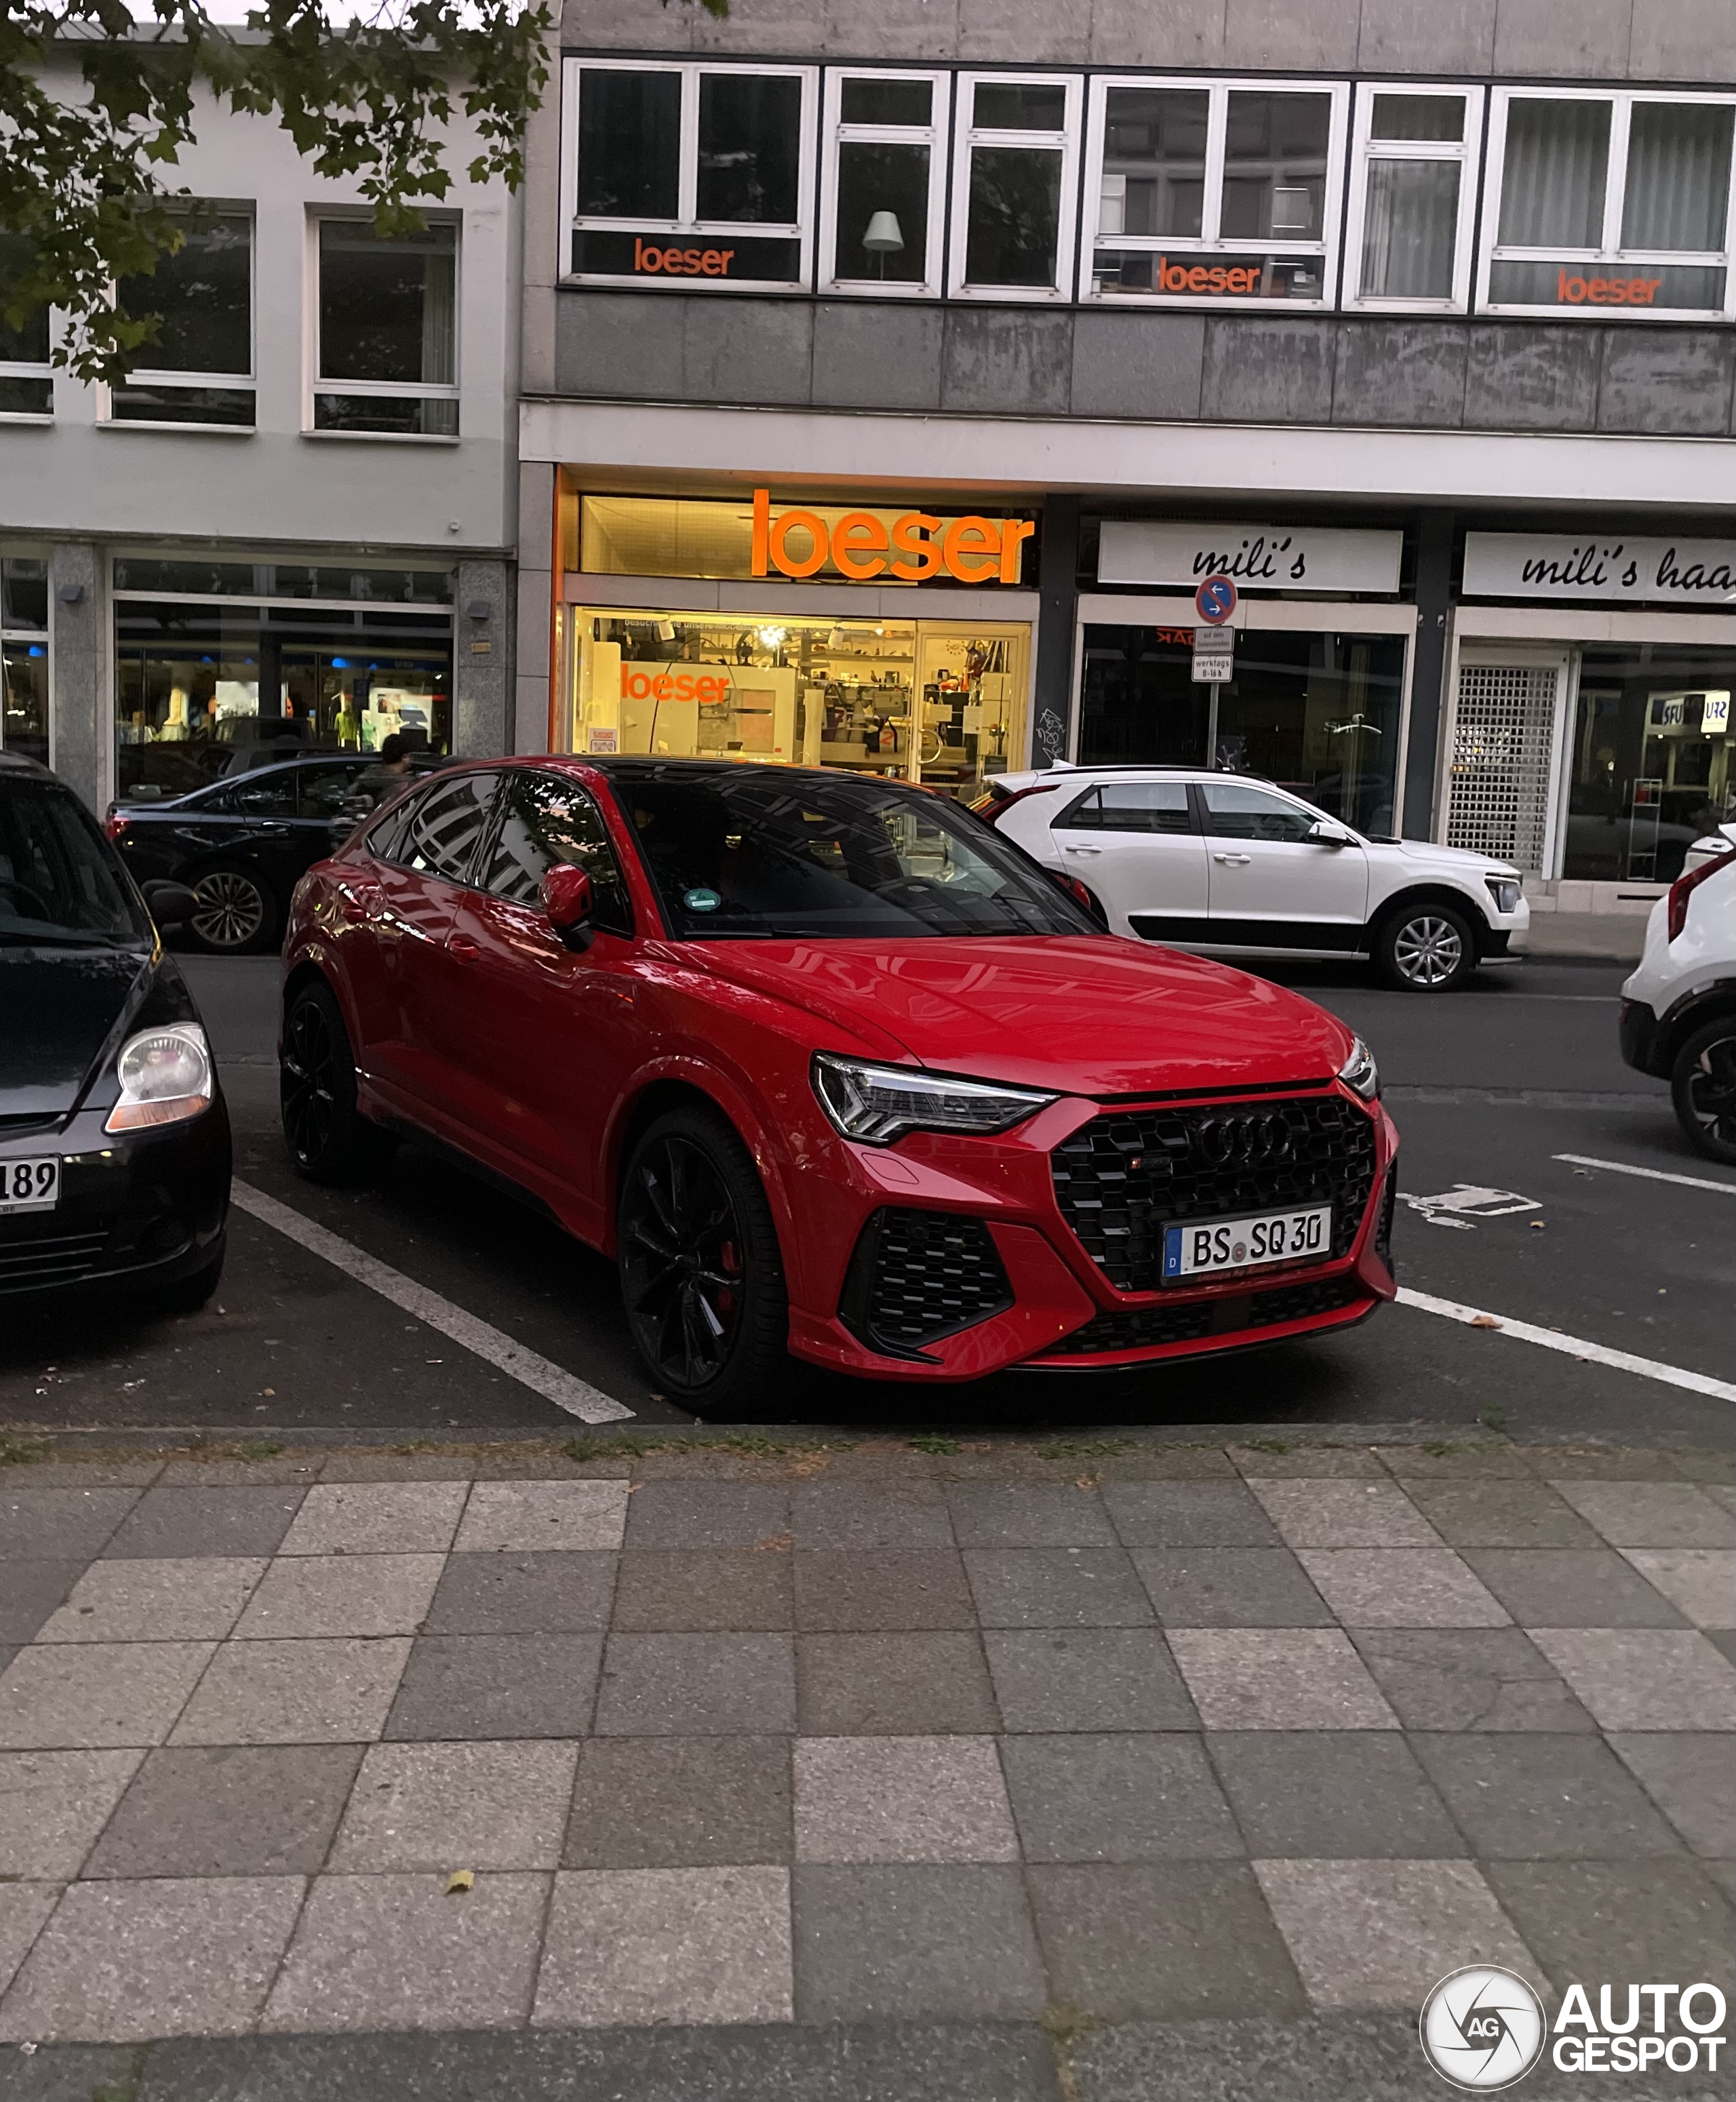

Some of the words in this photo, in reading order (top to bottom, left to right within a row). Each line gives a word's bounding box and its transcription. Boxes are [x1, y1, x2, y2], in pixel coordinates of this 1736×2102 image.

[635, 238, 734, 275] loeser
[1159, 257, 1261, 293] loeser
[1558, 267, 1661, 304] loeser
[751, 489, 1035, 584] loeser
[1193, 536, 1305, 579] mili's
[1522, 544, 1638, 587] mili's
[621, 663, 730, 703] loeser
[1196, 659, 1229, 669] werktags
[1169, 1258, 1177, 1269] D
[1194, 1227, 1230, 1267] BS
[1250, 1220, 1286, 1258] SQ
[1290, 1214, 1321, 1252] 30
